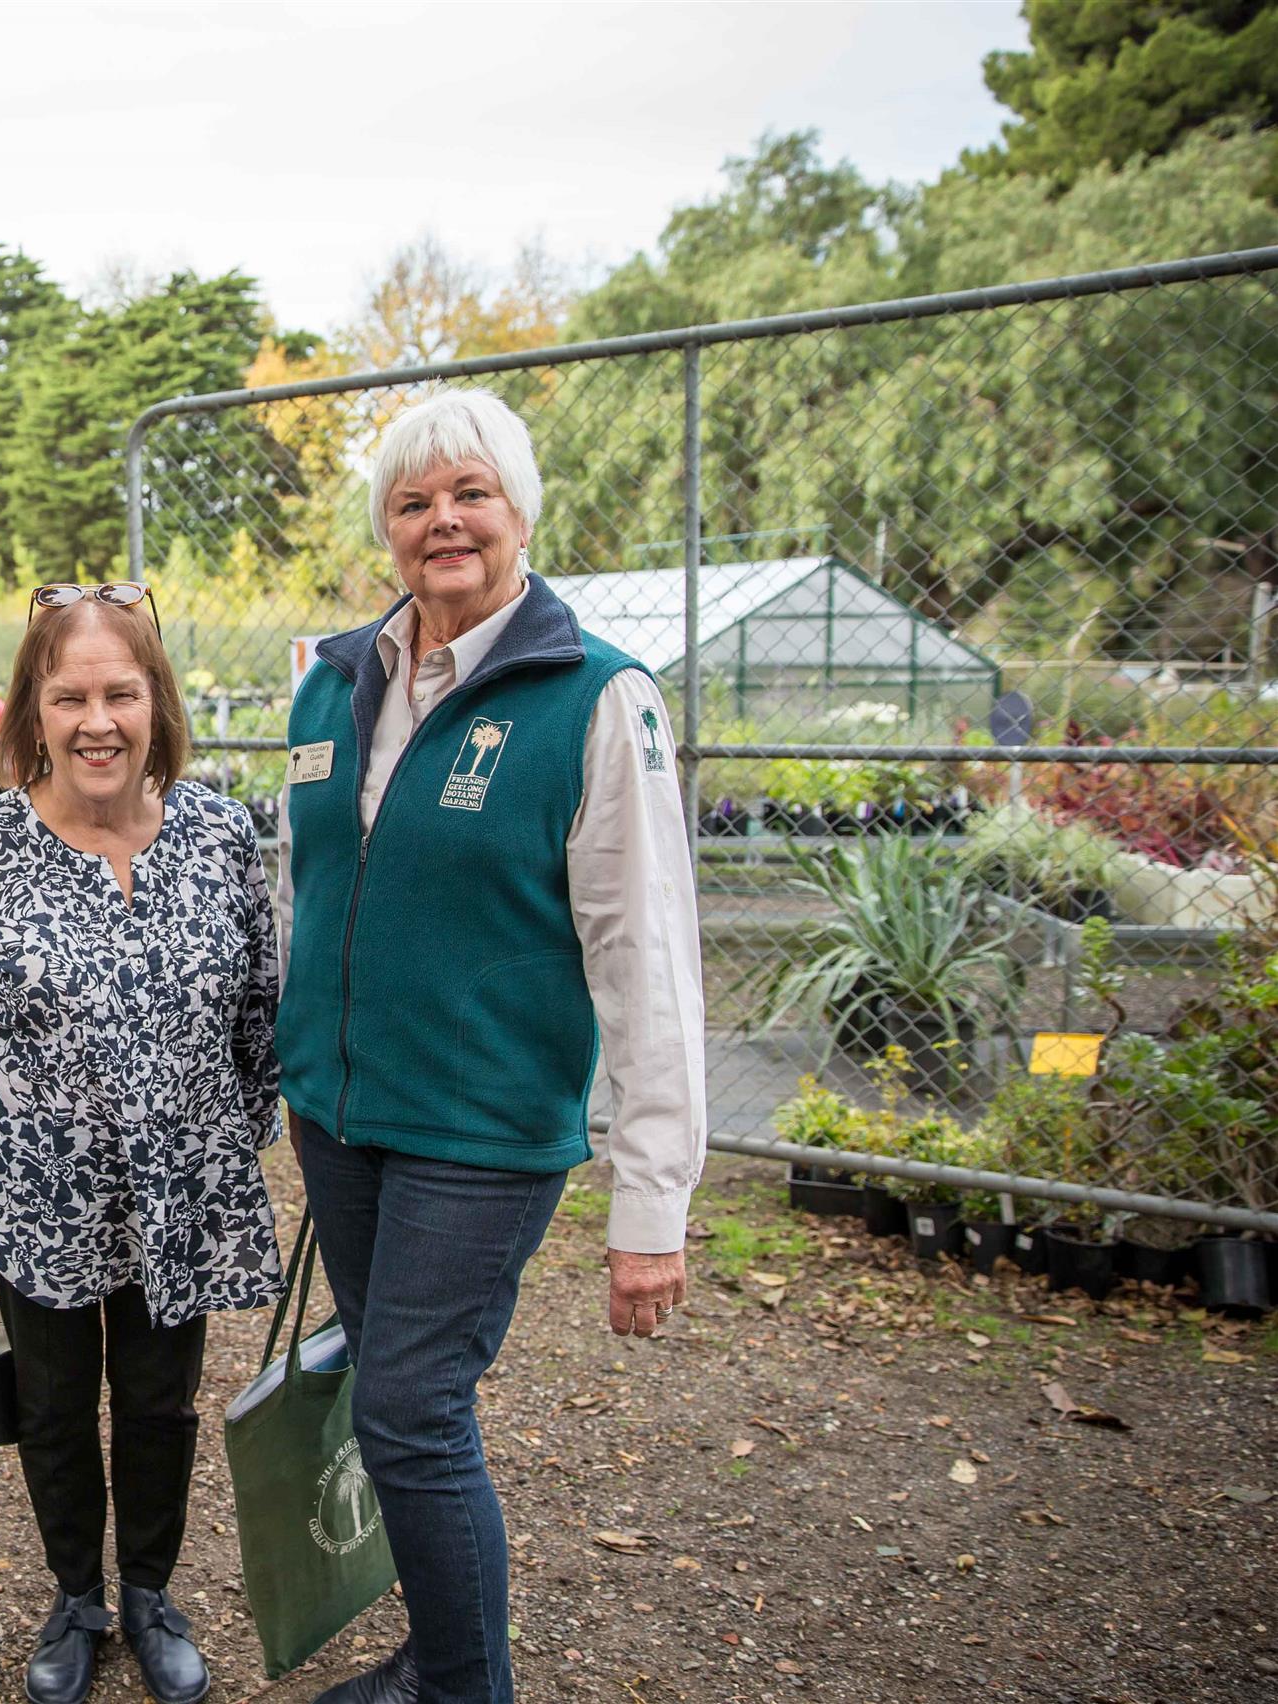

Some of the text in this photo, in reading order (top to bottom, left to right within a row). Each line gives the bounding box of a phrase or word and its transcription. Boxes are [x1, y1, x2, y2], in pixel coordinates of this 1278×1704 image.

[451, 776, 484, 785] FRIENDS
[448, 783, 484, 793] GEELONG
[445, 790, 482, 800] BOTANIC
[443, 797, 479, 808] GARDENS
[317, 1462, 335, 1487] THE
[308, 1518, 379, 1555] GEELONG BOTANIC
